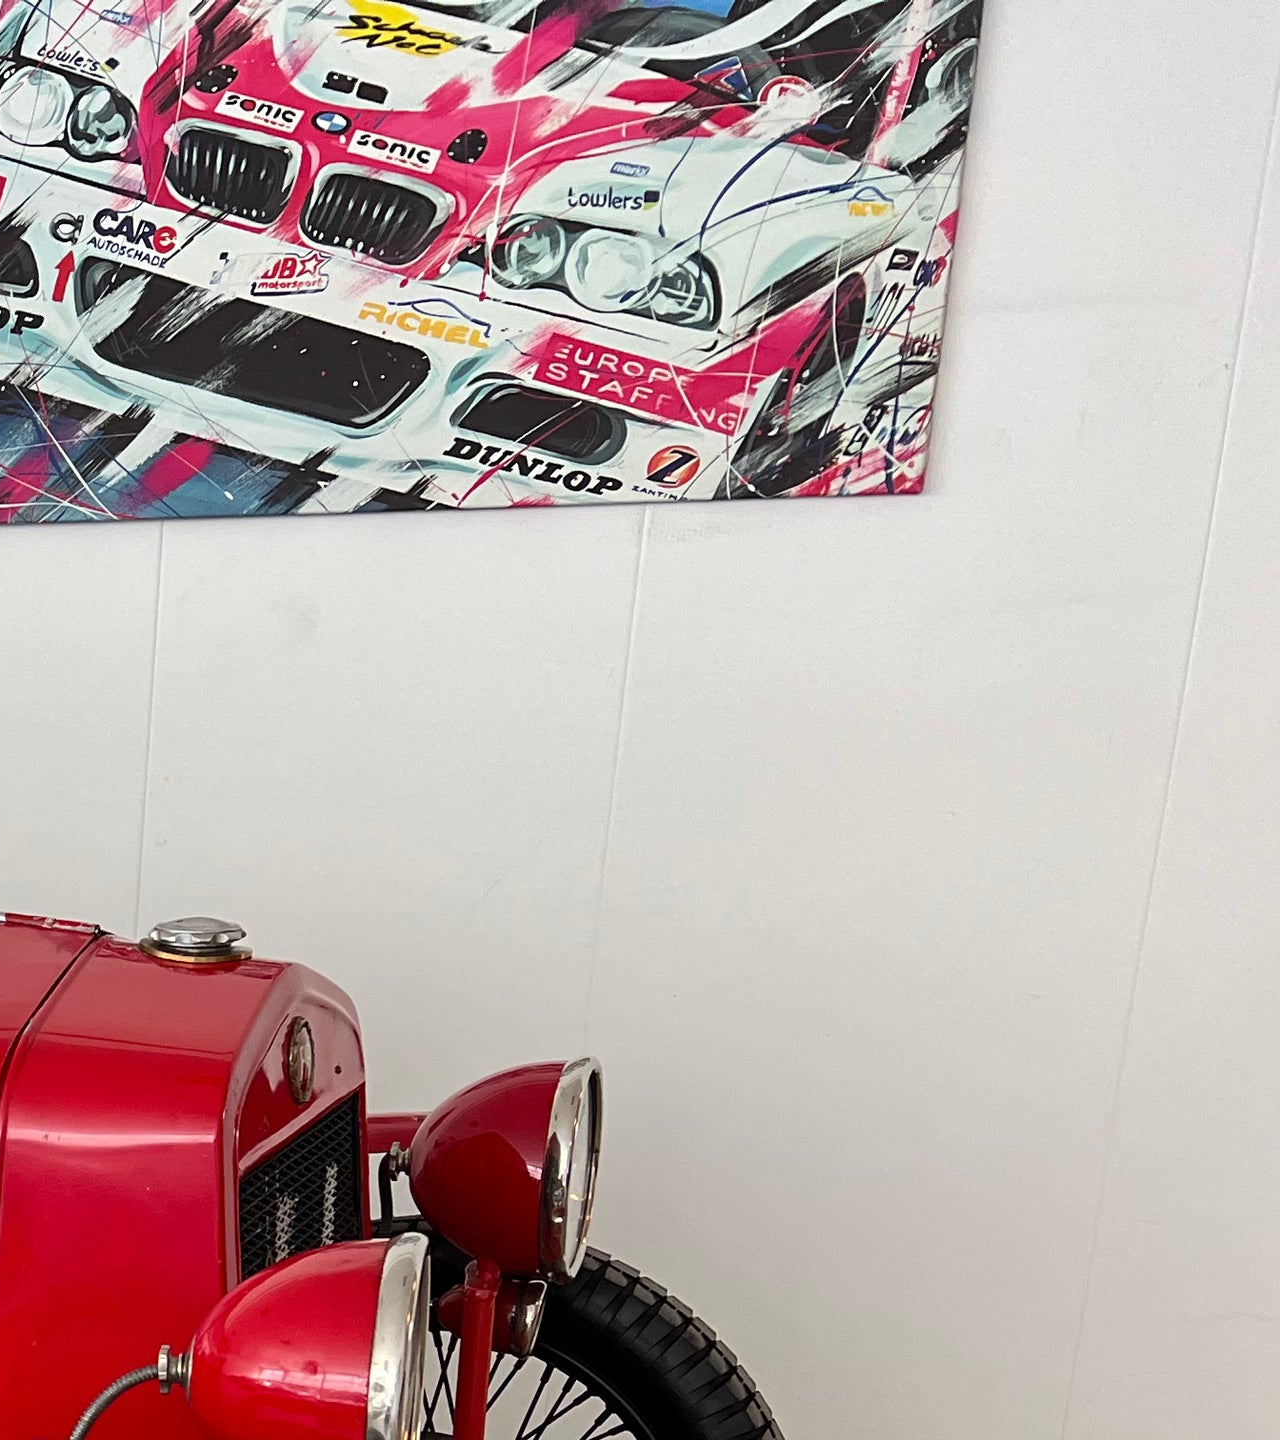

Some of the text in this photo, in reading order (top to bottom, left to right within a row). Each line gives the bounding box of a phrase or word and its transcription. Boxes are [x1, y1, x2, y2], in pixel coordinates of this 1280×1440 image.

[89, 234, 168, 268] AUTOSCHADE
[358, 302, 488, 348] RICHEL
[443, 437, 623, 496] DUNLOP
